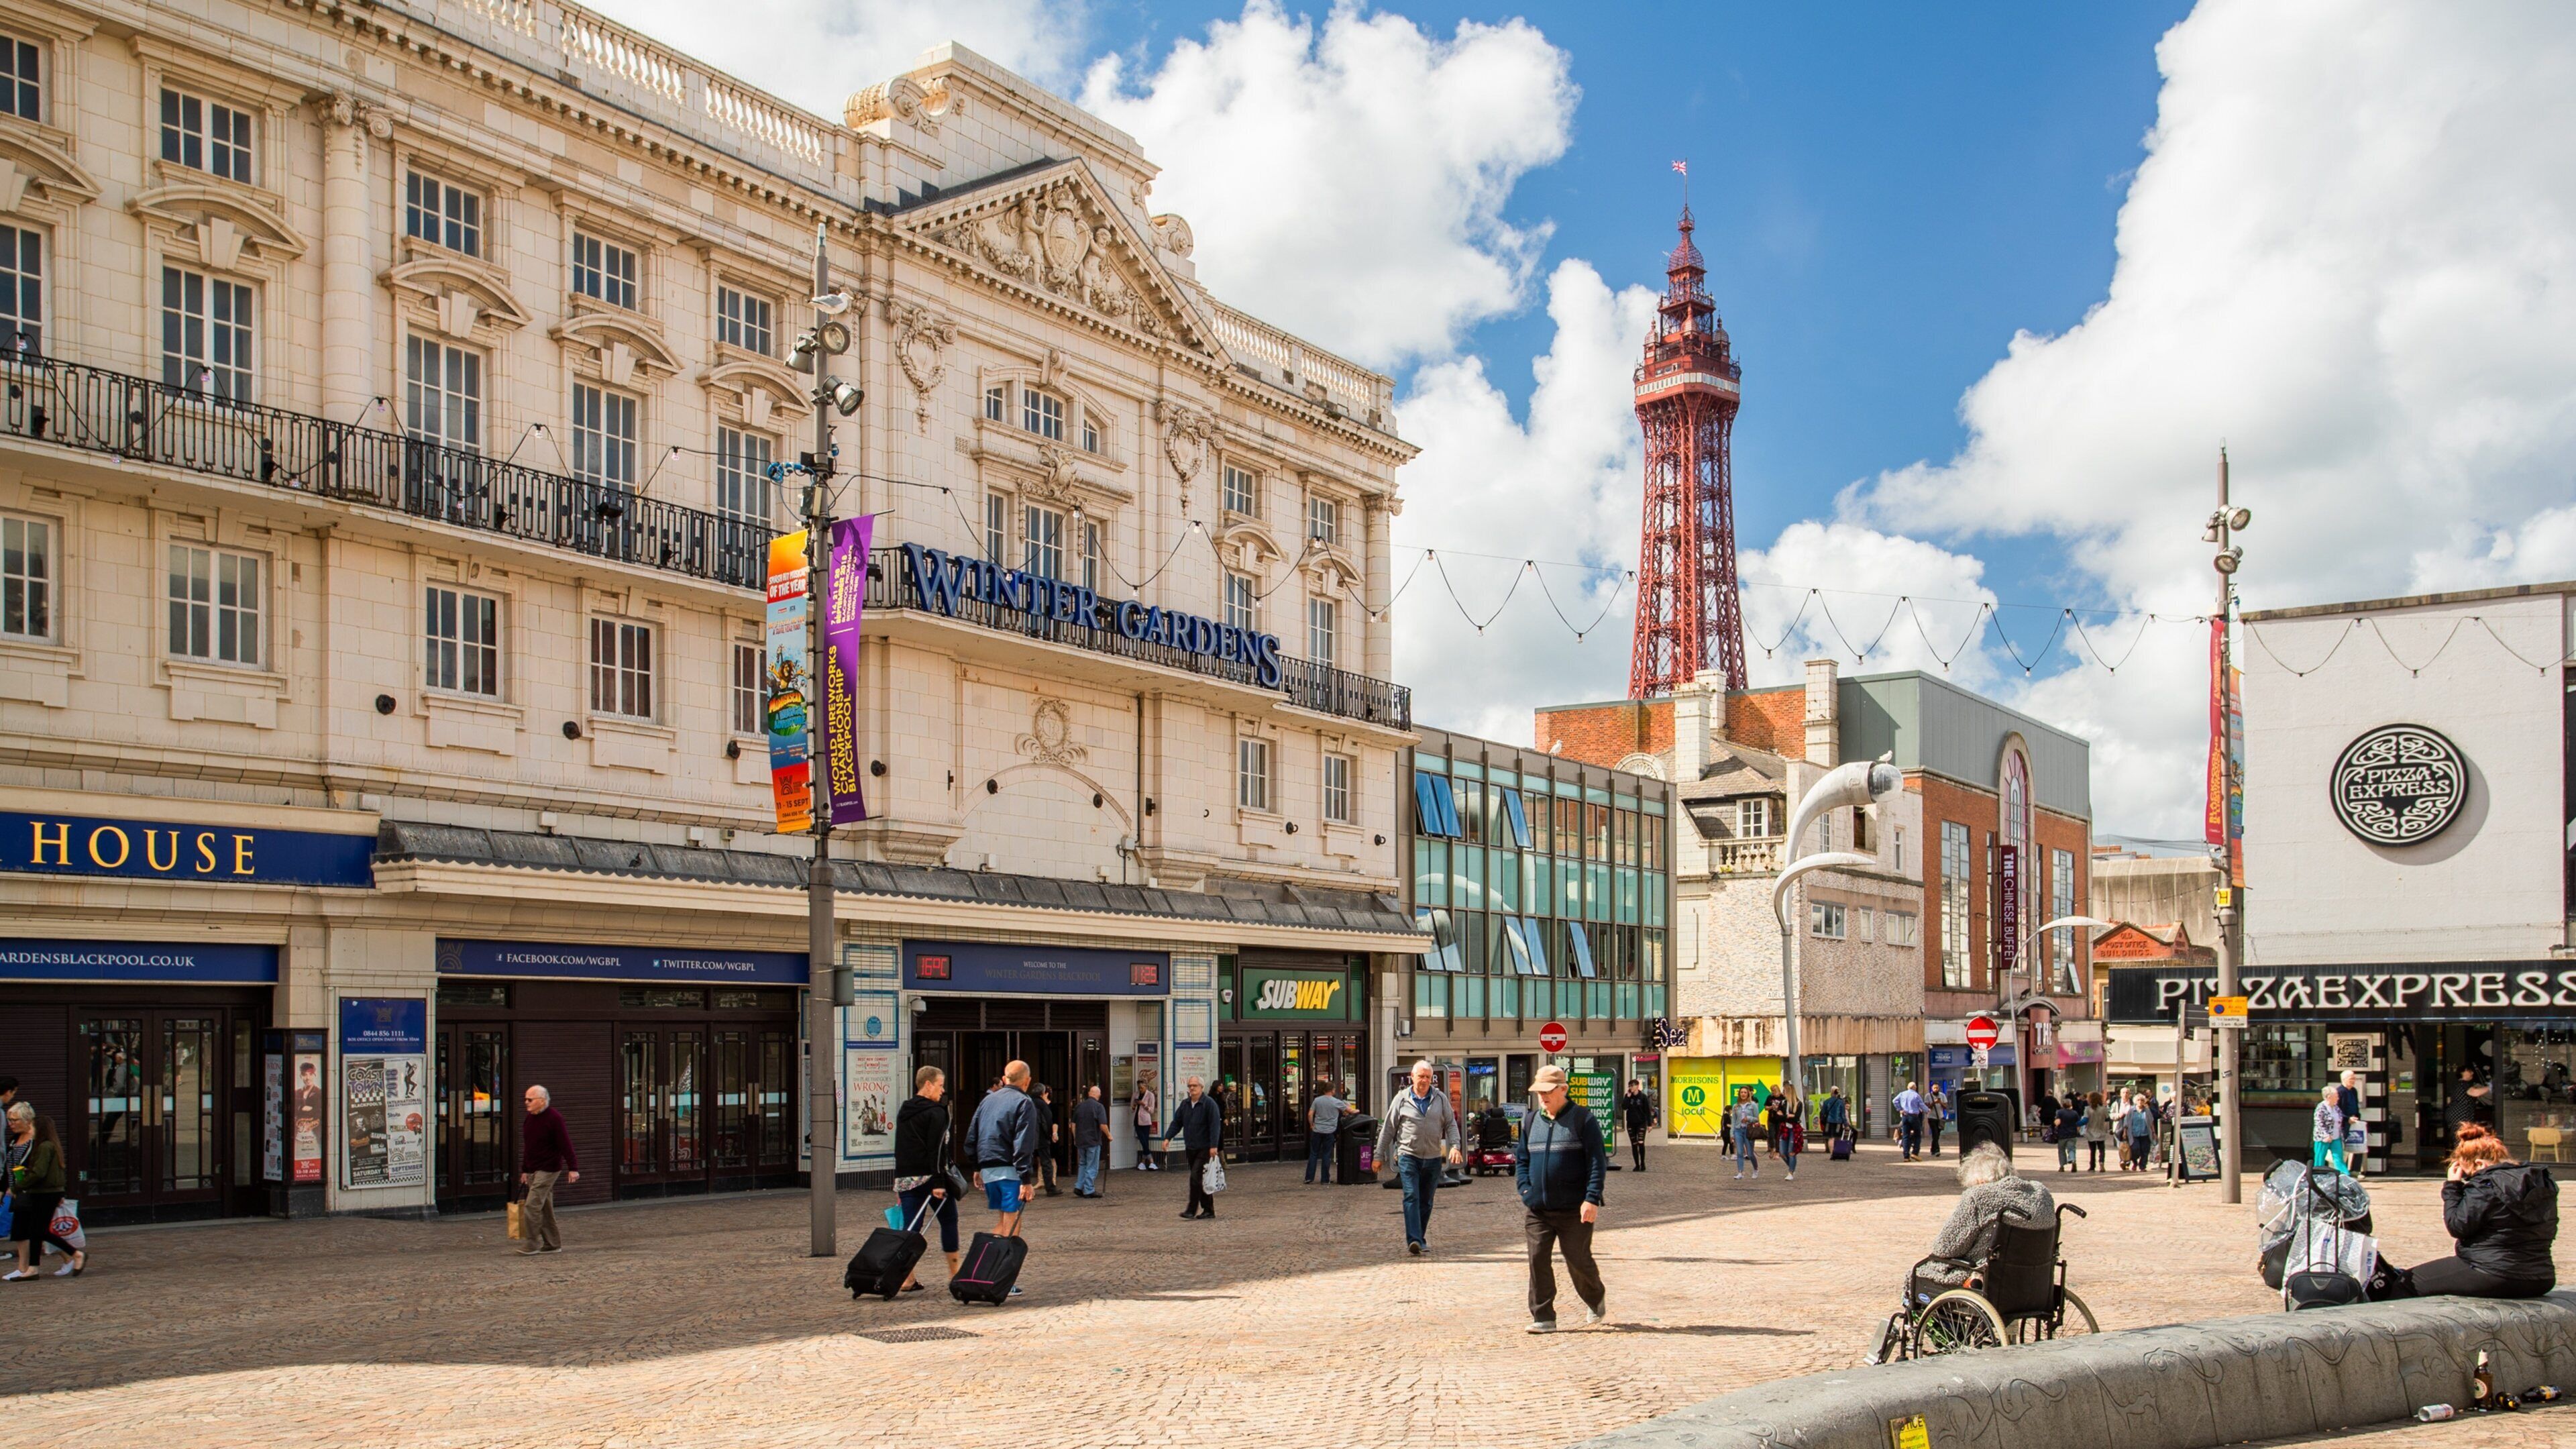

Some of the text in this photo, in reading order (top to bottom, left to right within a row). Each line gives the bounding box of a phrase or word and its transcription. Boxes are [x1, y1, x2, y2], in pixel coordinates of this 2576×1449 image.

[769, 578, 806, 598] OF THE YEAR
[836, 577, 845, 624] SEPTEMBER
[841, 585, 849, 623] BLACKPOOL
[902, 541, 1281, 688] WINTER GARDENS
[827, 645, 841, 796] WORLD FIREWORKS
[836, 668, 849, 794] CHAMPIONSHIP
[843, 694, 857, 793] BLACKPOOL
[2367, 766, 2431, 784] PIZZA
[2349, 780, 2451, 799] EXPRESS
[794, 798, 808, 807] SEPT
[30, 821, 256, 875] HOUSE
[2004, 853, 2015, 877] THE
[2125, 941, 2147, 949] OFFICE
[0, 952, 195, 967] ARDENSBLACKPOOL.CO.UK
[506, 953, 621, 967] FACEBOOK.COM/WGBPL
[662, 959, 756, 972] TWITTER.COM/WGBPL
[984, 968, 1102, 981] WINTER GARDENS BLACKPOOL
[1256, 978, 1340, 1010] SUBWAY
[2155, 971, 2576, 1010] PIZAEXPRESS
[347, 1067, 384, 1081] COAST
[1569, 1077, 1611, 1086] SUBWAY
[1670, 1076, 1719, 1084] MORRISONS
[347, 1079, 384, 1093] TOWN
[386, 1069, 398, 1098] 2018
[853, 1082, 890, 1094] WRONG
[1569, 1087, 1611, 1096] SUBWAY
[1686, 1089, 1701, 1103] M
[1682, 1107, 1706, 1116] local
[353, 1169, 382, 1177] SATURDAY
[391, 1164, 423, 1173] SEPTEMBER
[1900, 1416, 1923, 1431] OTICE
